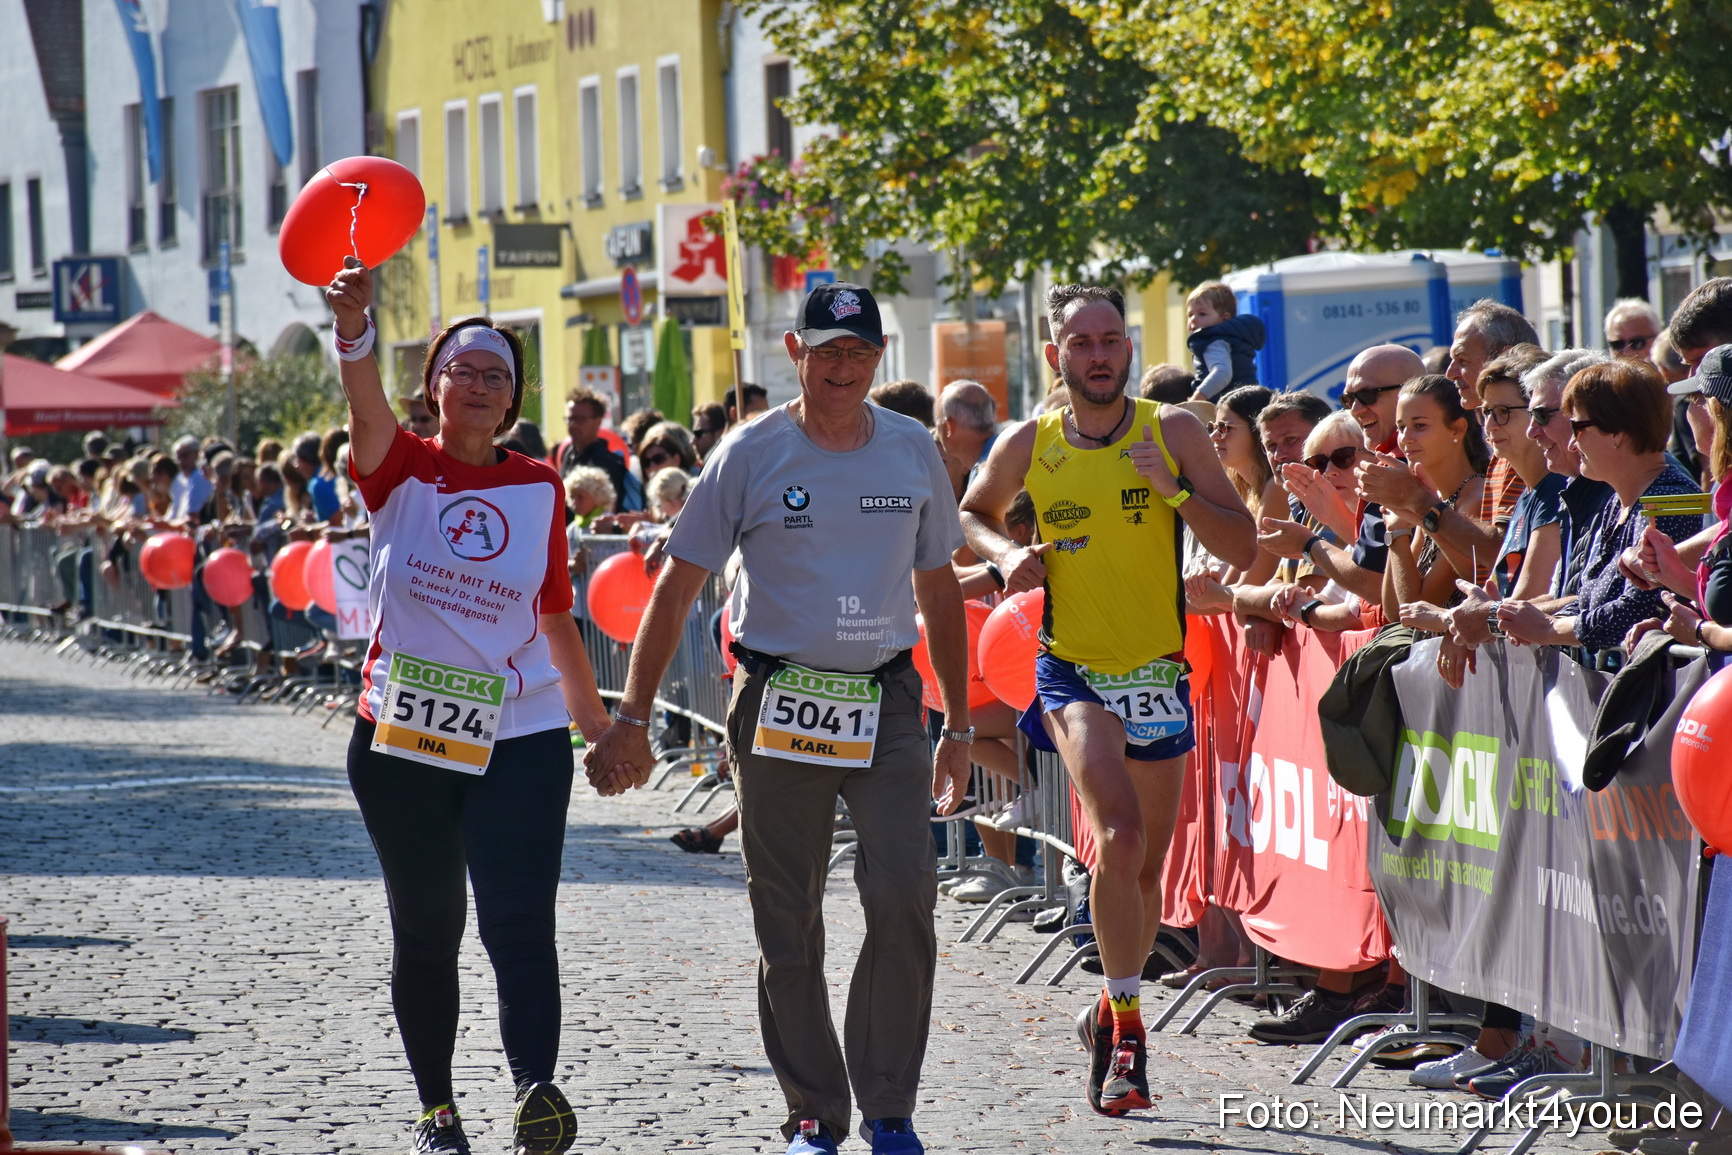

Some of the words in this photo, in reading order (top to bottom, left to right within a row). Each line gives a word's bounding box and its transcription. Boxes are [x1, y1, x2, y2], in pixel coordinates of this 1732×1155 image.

[453, 34, 496, 85] HOTEL
[498, 251, 559, 264] TAIFUN
[1323, 304, 1363, 319] 08141
[1375, 302, 1399, 317] 536
[1403, 300, 1420, 314] 80
[860, 496, 912, 509] BOCK
[1121, 488, 1150, 505] MTP
[784, 515, 813, 524] PARTL
[1046, 506, 1084, 521] FRANCESCO
[411, 576, 424, 587] Dr.
[426, 581, 451, 595] Heck
[458, 590, 472, 602] Dr.
[474, 594, 506, 612] Röschl
[837, 595, 866, 614] 19.
[409, 588, 499, 625] Leistungsdiagnostik
[837, 616, 891, 627] Neumarkter
[836, 629, 884, 641] Stadtlauf
[397, 658, 496, 701] BOCK
[775, 668, 872, 700] BOCK
[393, 690, 484, 739] 5124
[773, 695, 862, 737] 5041
[1115, 692, 1172, 718] 131
[417, 737, 447, 755] INA
[791, 738, 837, 755] KARL
[1391, 740, 1498, 836] BOCK
[1588, 783, 1694, 841] LOUNG
[1382, 843, 1430, 884] inspired
[1433, 850, 1445, 889] by
